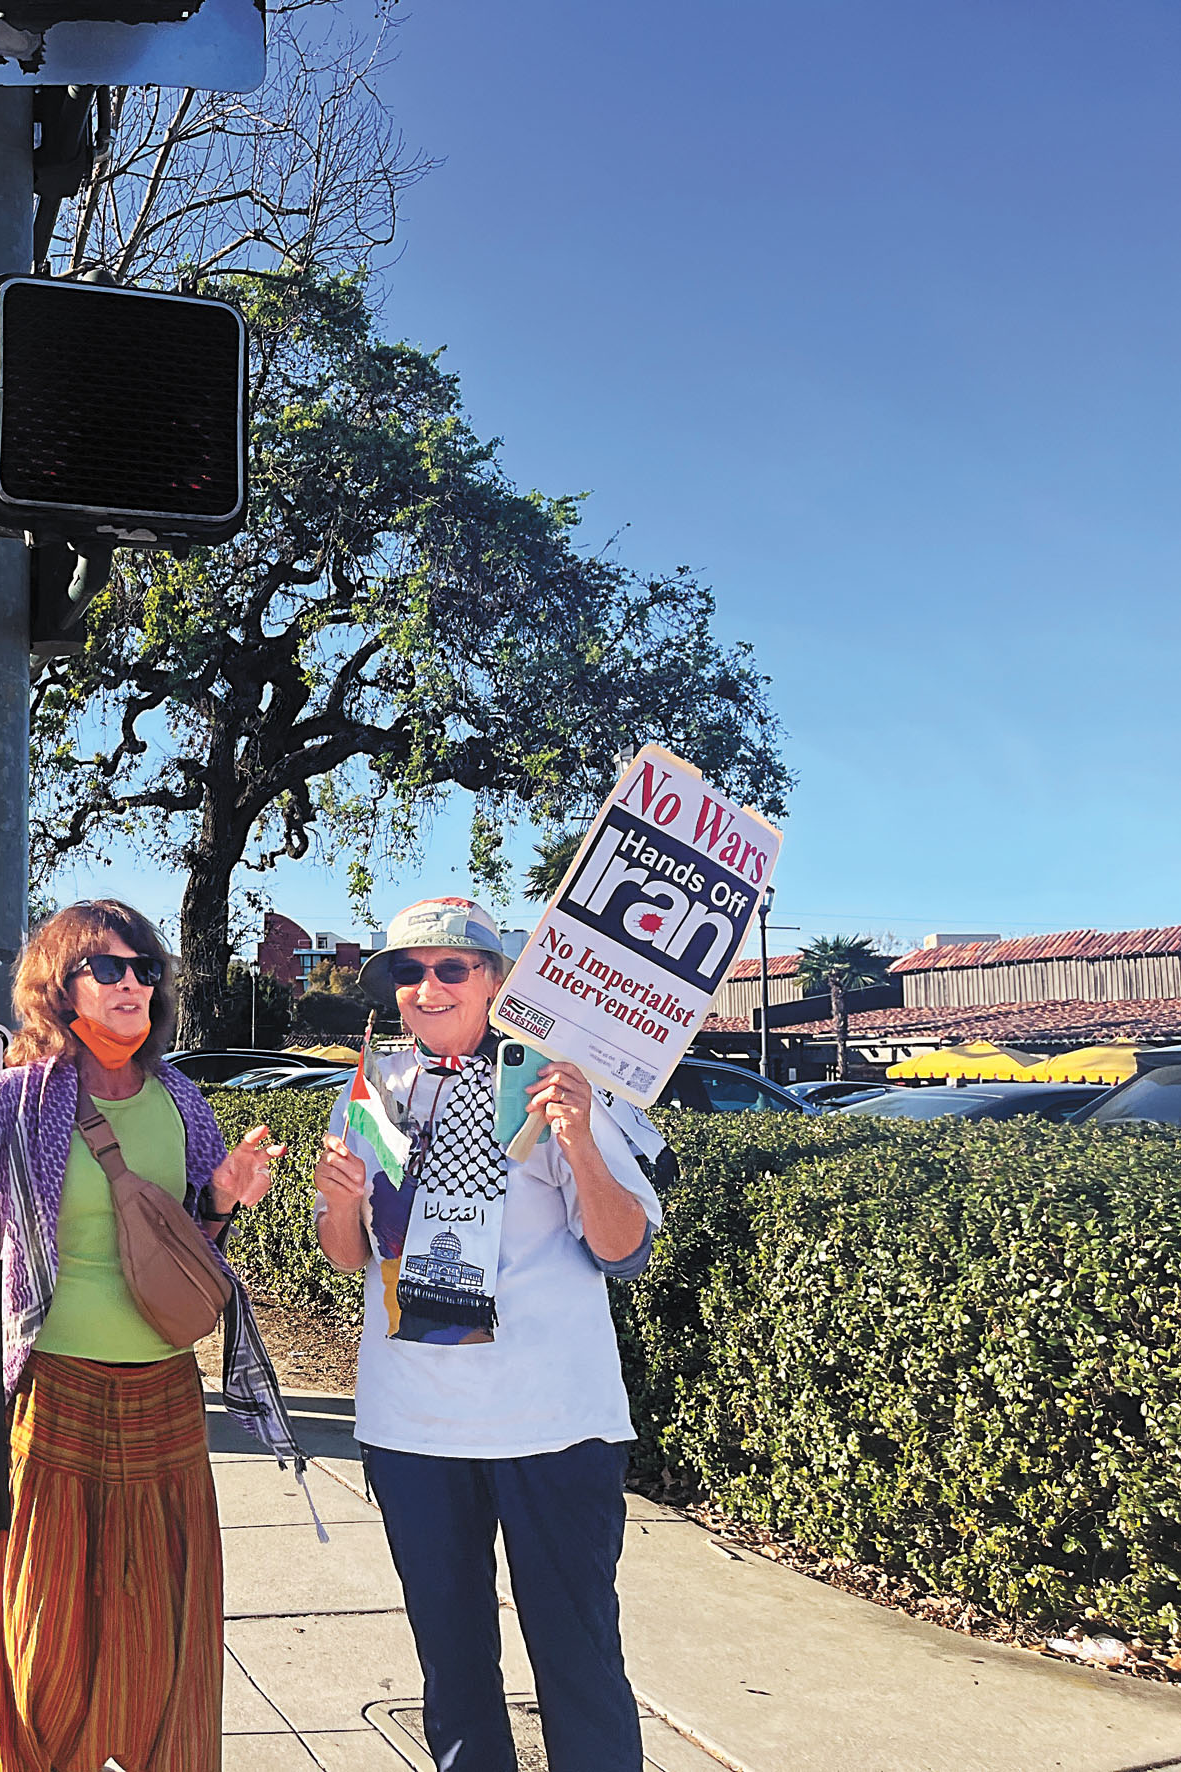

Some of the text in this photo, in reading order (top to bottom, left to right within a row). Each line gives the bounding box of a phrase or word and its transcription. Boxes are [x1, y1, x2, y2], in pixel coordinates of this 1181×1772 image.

[618, 760, 768, 885] No Wars
[568, 824, 734, 979] Iran
[620, 828, 749, 918] Hands Off
[524, 1008, 551, 1030] FREE
[536, 954, 670, 1044] Intervention
[538, 926, 696, 1028] No Imperialist
[500, 1008, 546, 1037] PALESTINE
